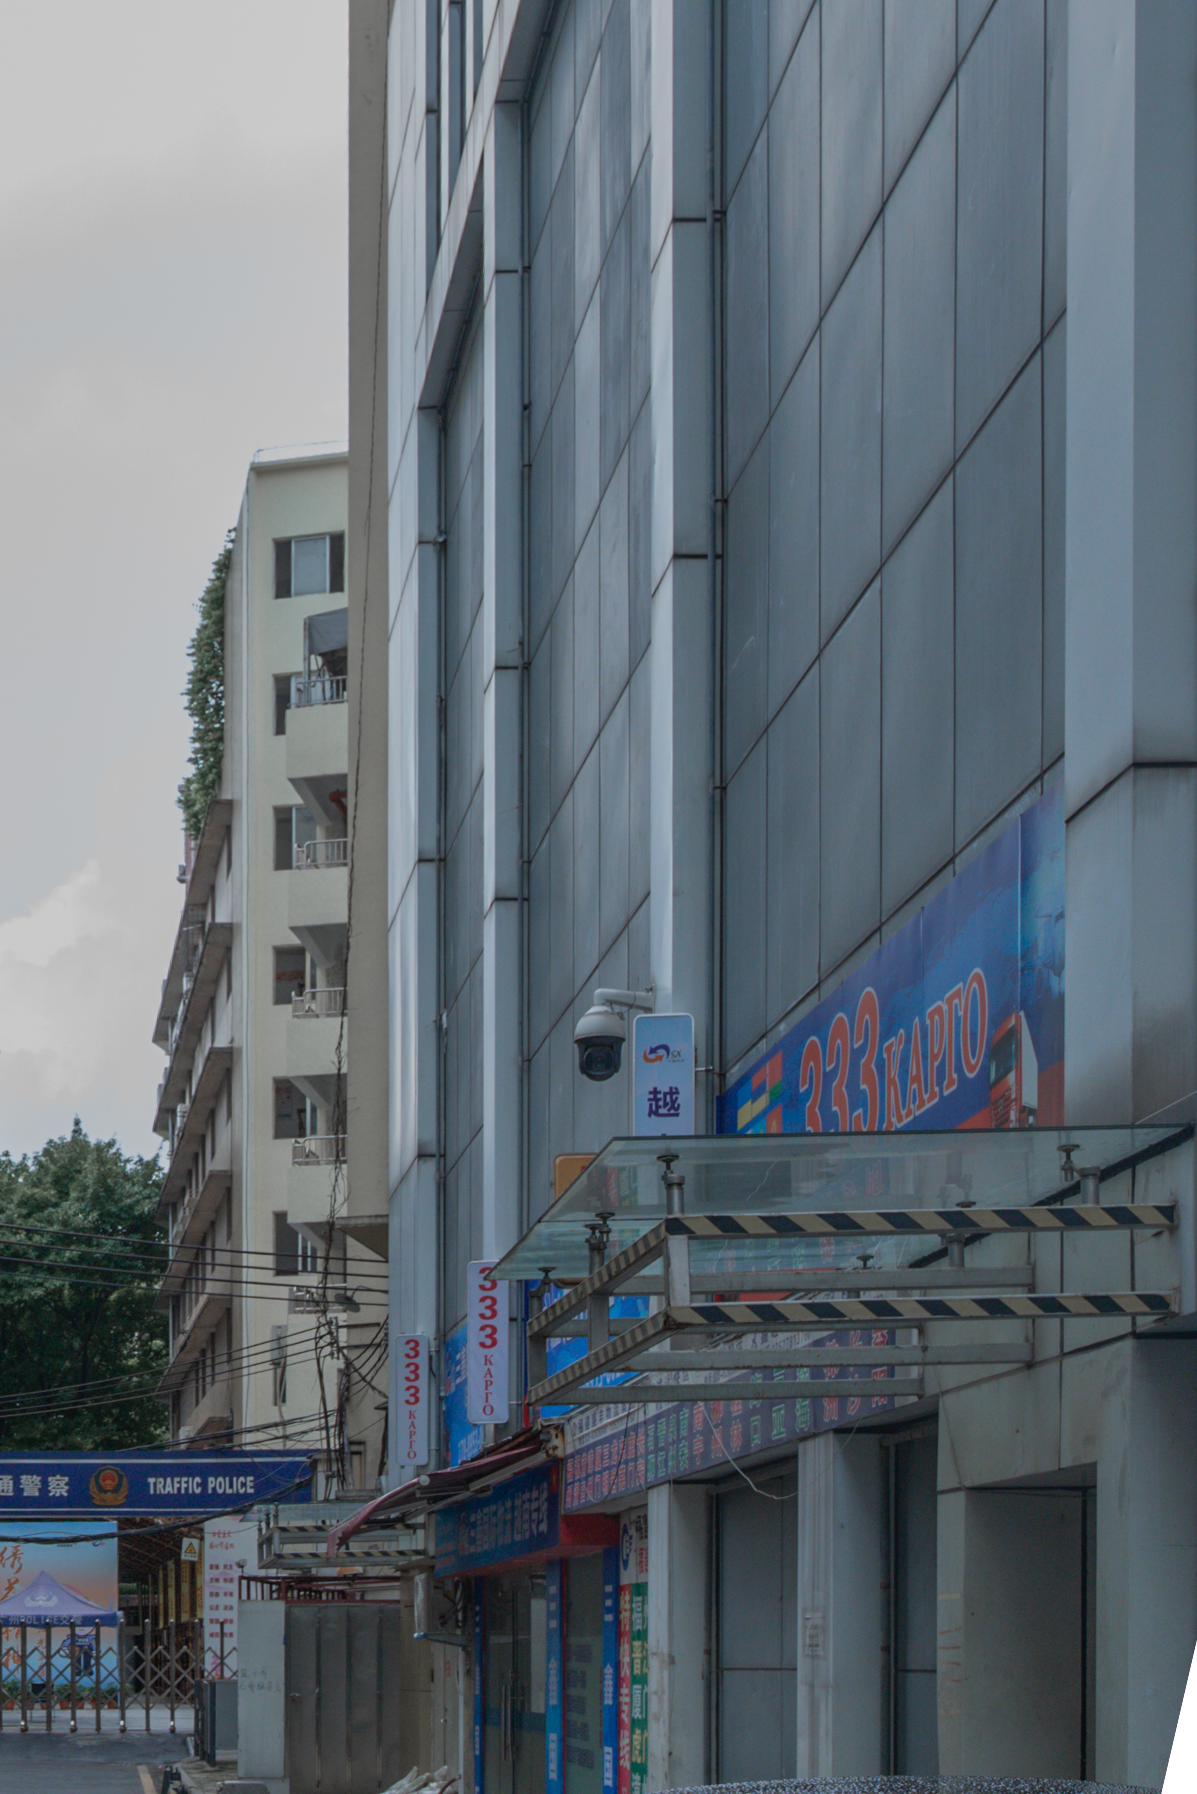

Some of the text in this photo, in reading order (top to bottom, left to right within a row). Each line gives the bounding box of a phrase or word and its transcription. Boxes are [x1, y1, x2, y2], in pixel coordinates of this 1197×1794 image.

[799, 986, 880, 1133] 333
[647, 1086, 681, 1119] 越
[404, 1338, 421, 1406] 333
[478, 1266, 498, 1417] 333 КАРГО
[147, 1475, 255, 1495] TRAFFIC POLICE
